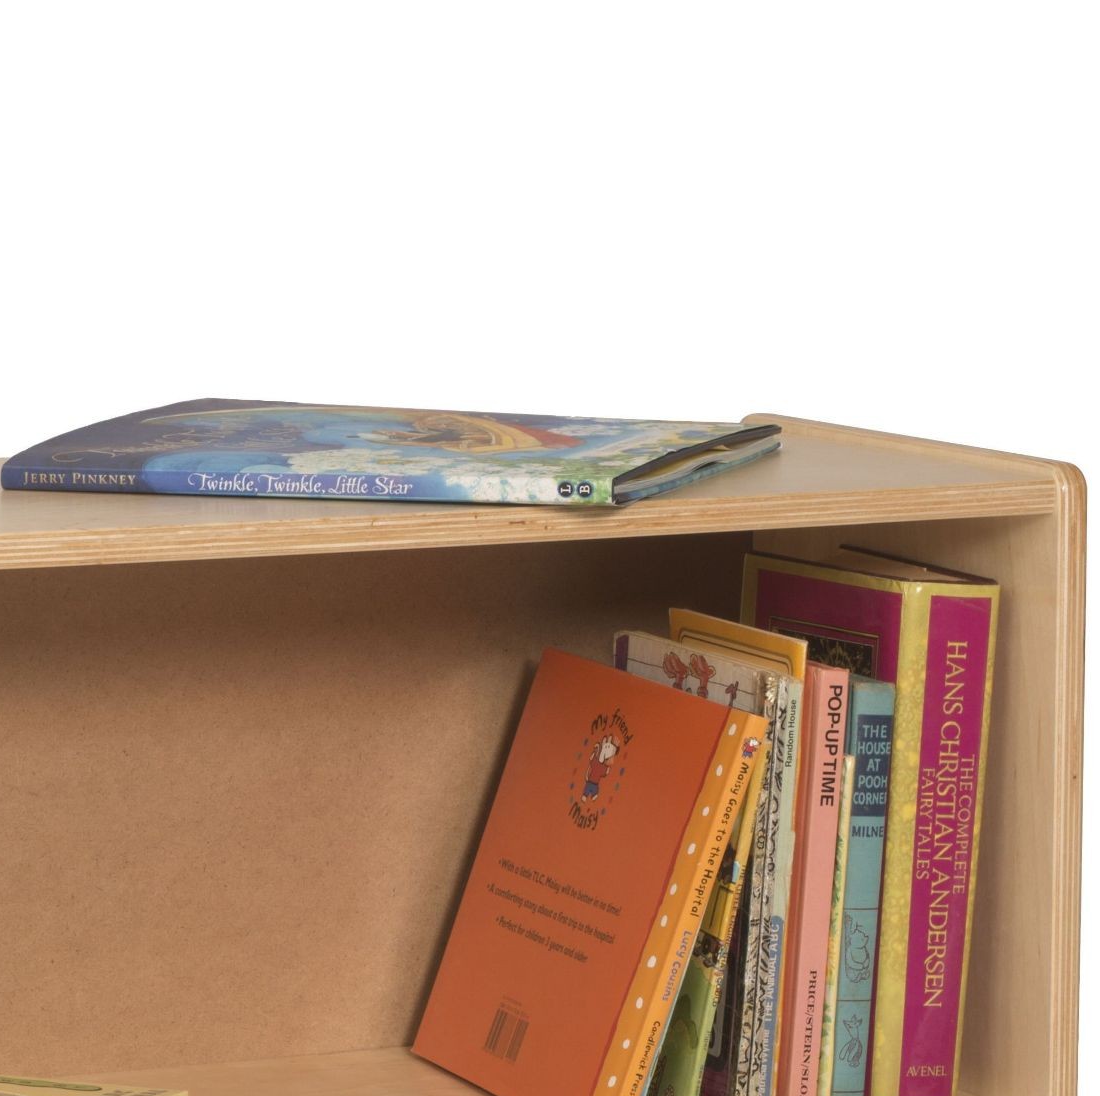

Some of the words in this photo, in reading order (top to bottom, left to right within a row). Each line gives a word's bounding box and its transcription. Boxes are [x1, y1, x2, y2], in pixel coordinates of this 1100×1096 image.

[23, 471, 66, 485] JERRY
[72, 472, 137, 486] PINKNEY
[187, 472, 258, 493] Twinkle,
[258, 473, 325, 494] Twinkle,
[328, 475, 368, 494] Little
[372, 475, 413, 495] Star
[942, 640, 967, 715] HANS
[590, 714, 608, 735] My
[609, 707, 634, 745] friend
[788, 699, 797, 729] House
[824, 685, 843, 756] POP-UP
[857, 740, 891, 755] HOUSE
[862, 724, 888, 739] THE
[785, 730, 794, 768] Random
[730, 762, 750, 796] Maisy
[866, 758, 881, 773] AT
[959, 754, 975, 791] THE
[820, 758, 837, 807] TIME
[857, 775, 888, 789] POOH
[919, 768, 936, 823] FAIRY
[933, 720, 961, 861] CHRISTIAN
[568, 801, 599, 831] Maisy
[721, 797, 738, 825] Goes
[715, 826, 726, 842] to
[851, 825, 884, 838] MILNE
[952, 794, 972, 895] COMPLETE
[708, 845, 721, 867] the
[915, 825, 932, 880] TALES
[690, 868, 714, 918] Hospital
[675, 930, 693, 959] Lucy
[923, 868, 951, 1008] ANDERSEN
[662, 961, 681, 1002] Cousins
[636, 1020, 661, 1070] Candlewick
[629, 1066, 646, 1096] Press
[906, 1065, 947, 1077] AVENEL
